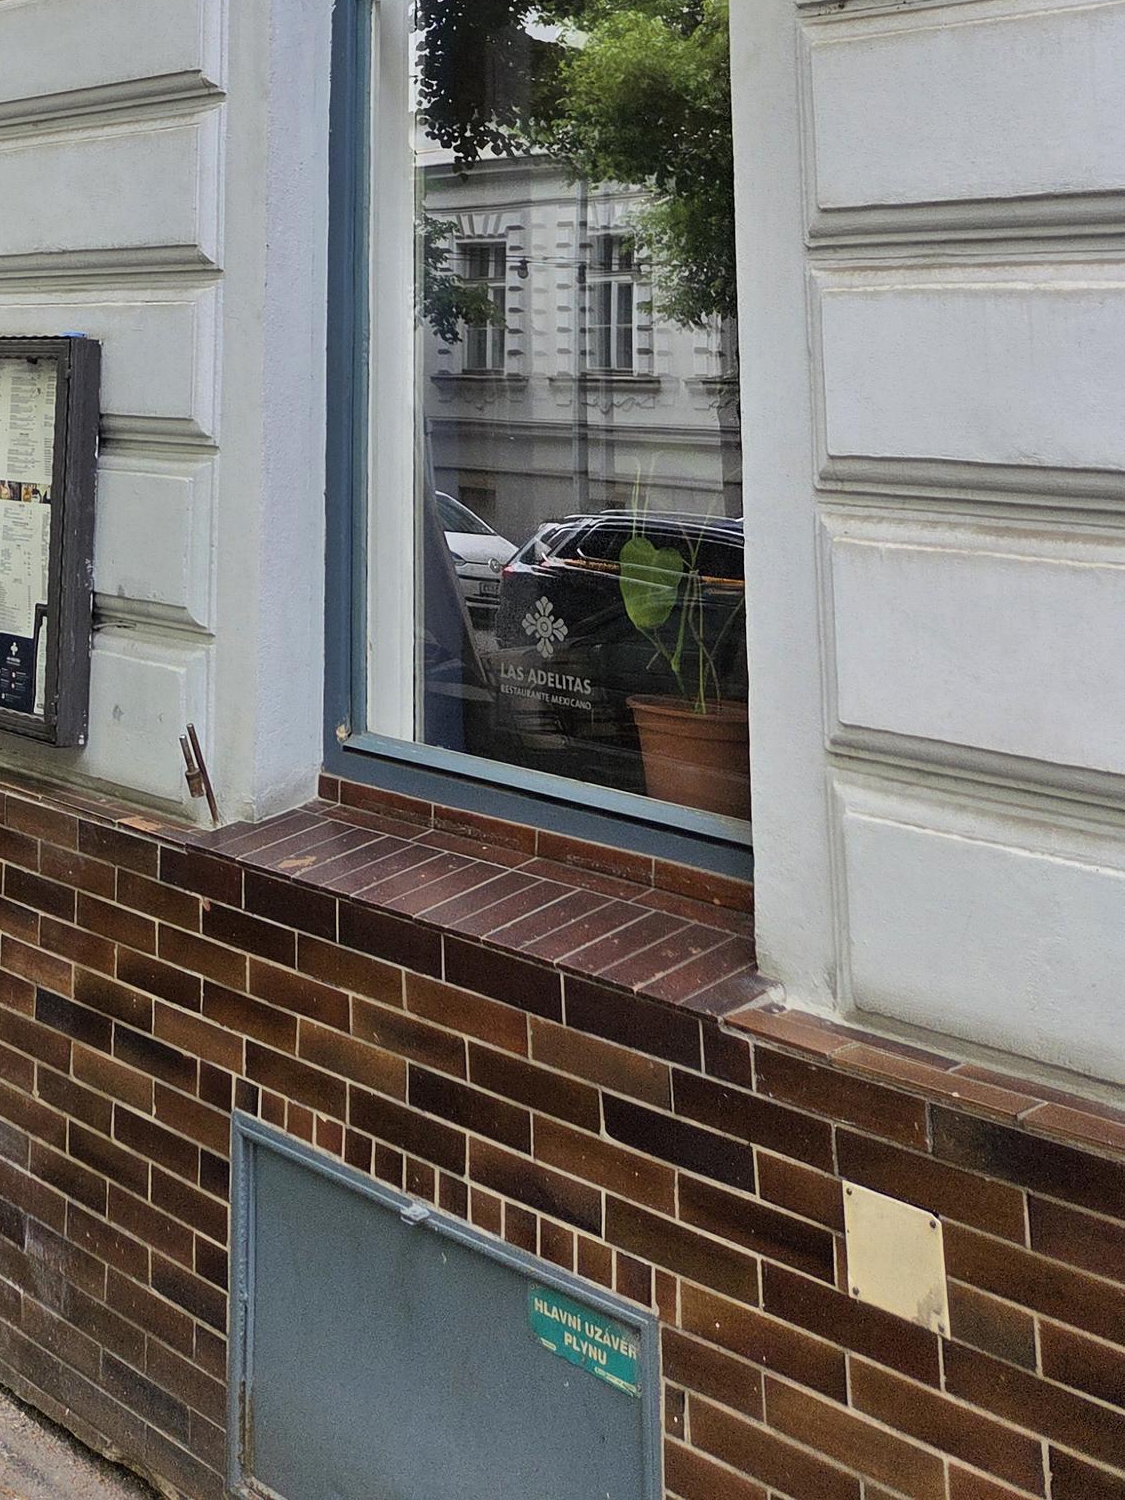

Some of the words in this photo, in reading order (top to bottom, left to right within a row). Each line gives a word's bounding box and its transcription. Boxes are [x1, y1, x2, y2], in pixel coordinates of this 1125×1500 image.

[501, 663, 524, 681] LAS
[528, 668, 592, 695] ADELITAS
[501, 684, 550, 703] RESTAURANTE
[551, 694, 592, 711] MEXICANO
[534, 1297, 581, 1332] HLAVNÍ
[564, 1331, 607, 1365] PLYNU
